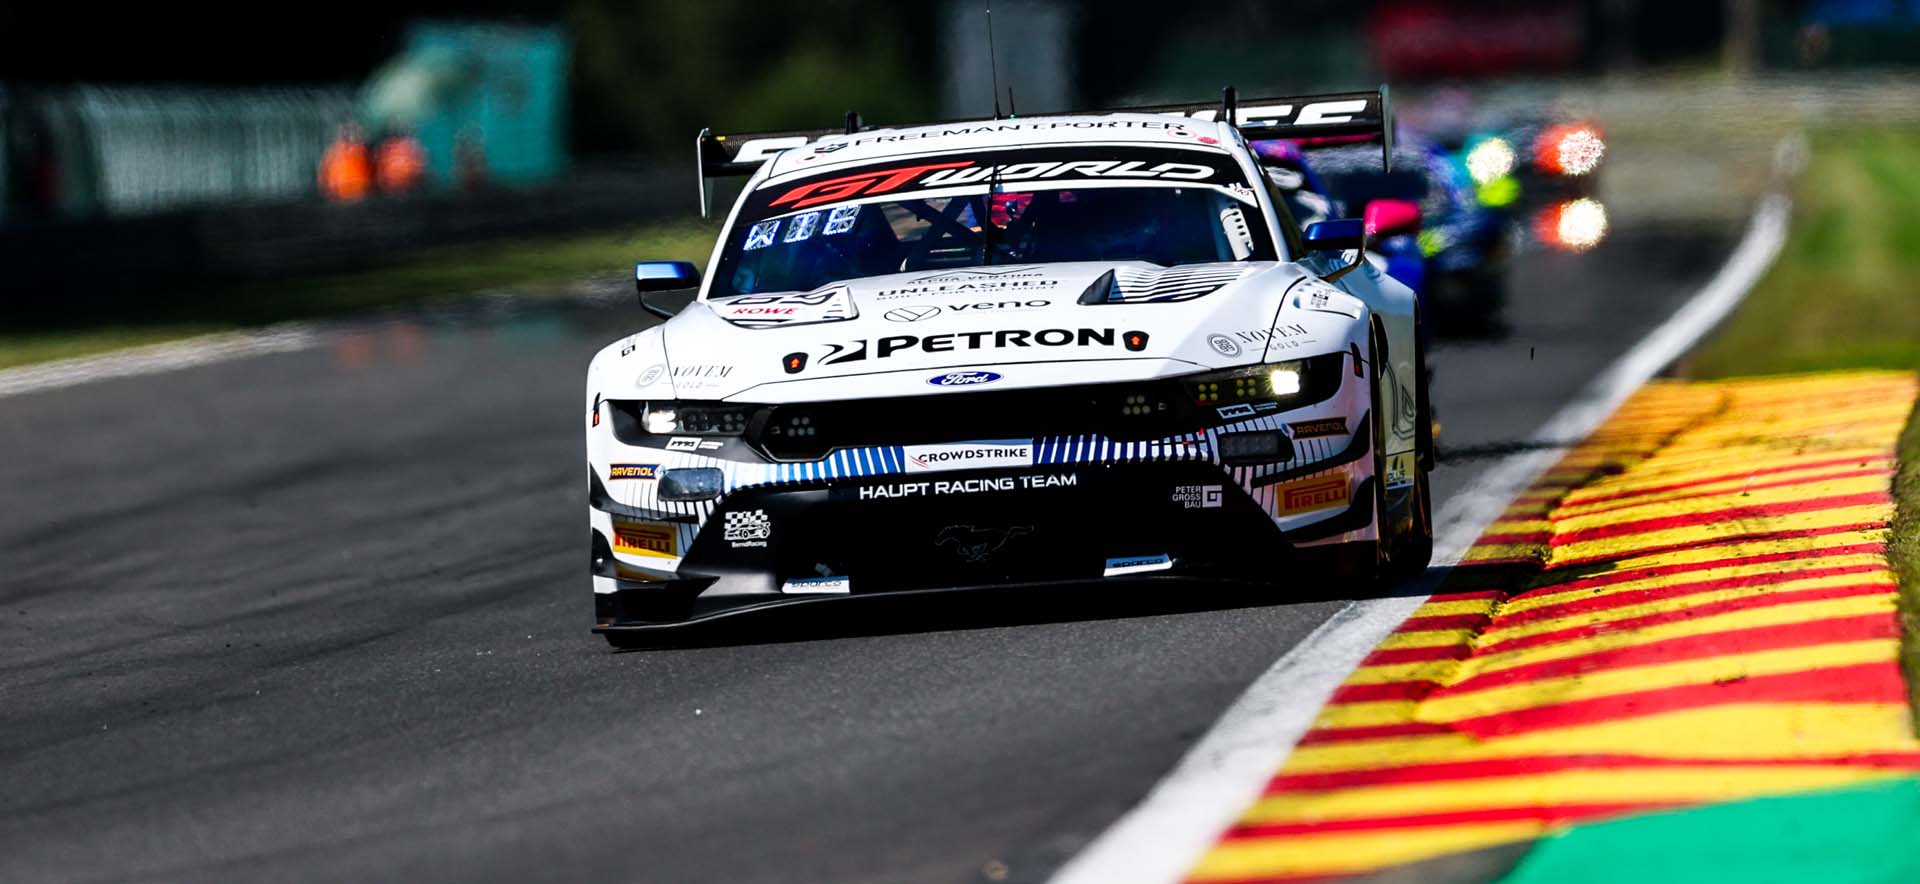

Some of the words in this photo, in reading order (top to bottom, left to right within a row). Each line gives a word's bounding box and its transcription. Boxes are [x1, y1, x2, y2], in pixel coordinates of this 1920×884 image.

[855, 124, 1021, 146] FREEMAN
[878, 280, 1058, 297] UNLEASHED
[733, 307, 798, 315] ROWE
[948, 299, 1051, 311] veno
[1236, 323, 1308, 344] NOVEM
[877, 328, 1115, 358] PETRON
[941, 371, 990, 386] Ford
[918, 448, 1028, 463] CROWDSTRIKE
[612, 466, 654, 477] RAVENOL
[860, 482, 930, 500] HAUPT
[935, 477, 1015, 495] RACING
[1019, 472, 1077, 489] TEAM
[1284, 479, 1346, 509] PIRELLI
[1172, 493, 1201, 501] GROSS
[1184, 501, 1201, 509] BAU
[615, 528, 671, 552] PIRELLI
